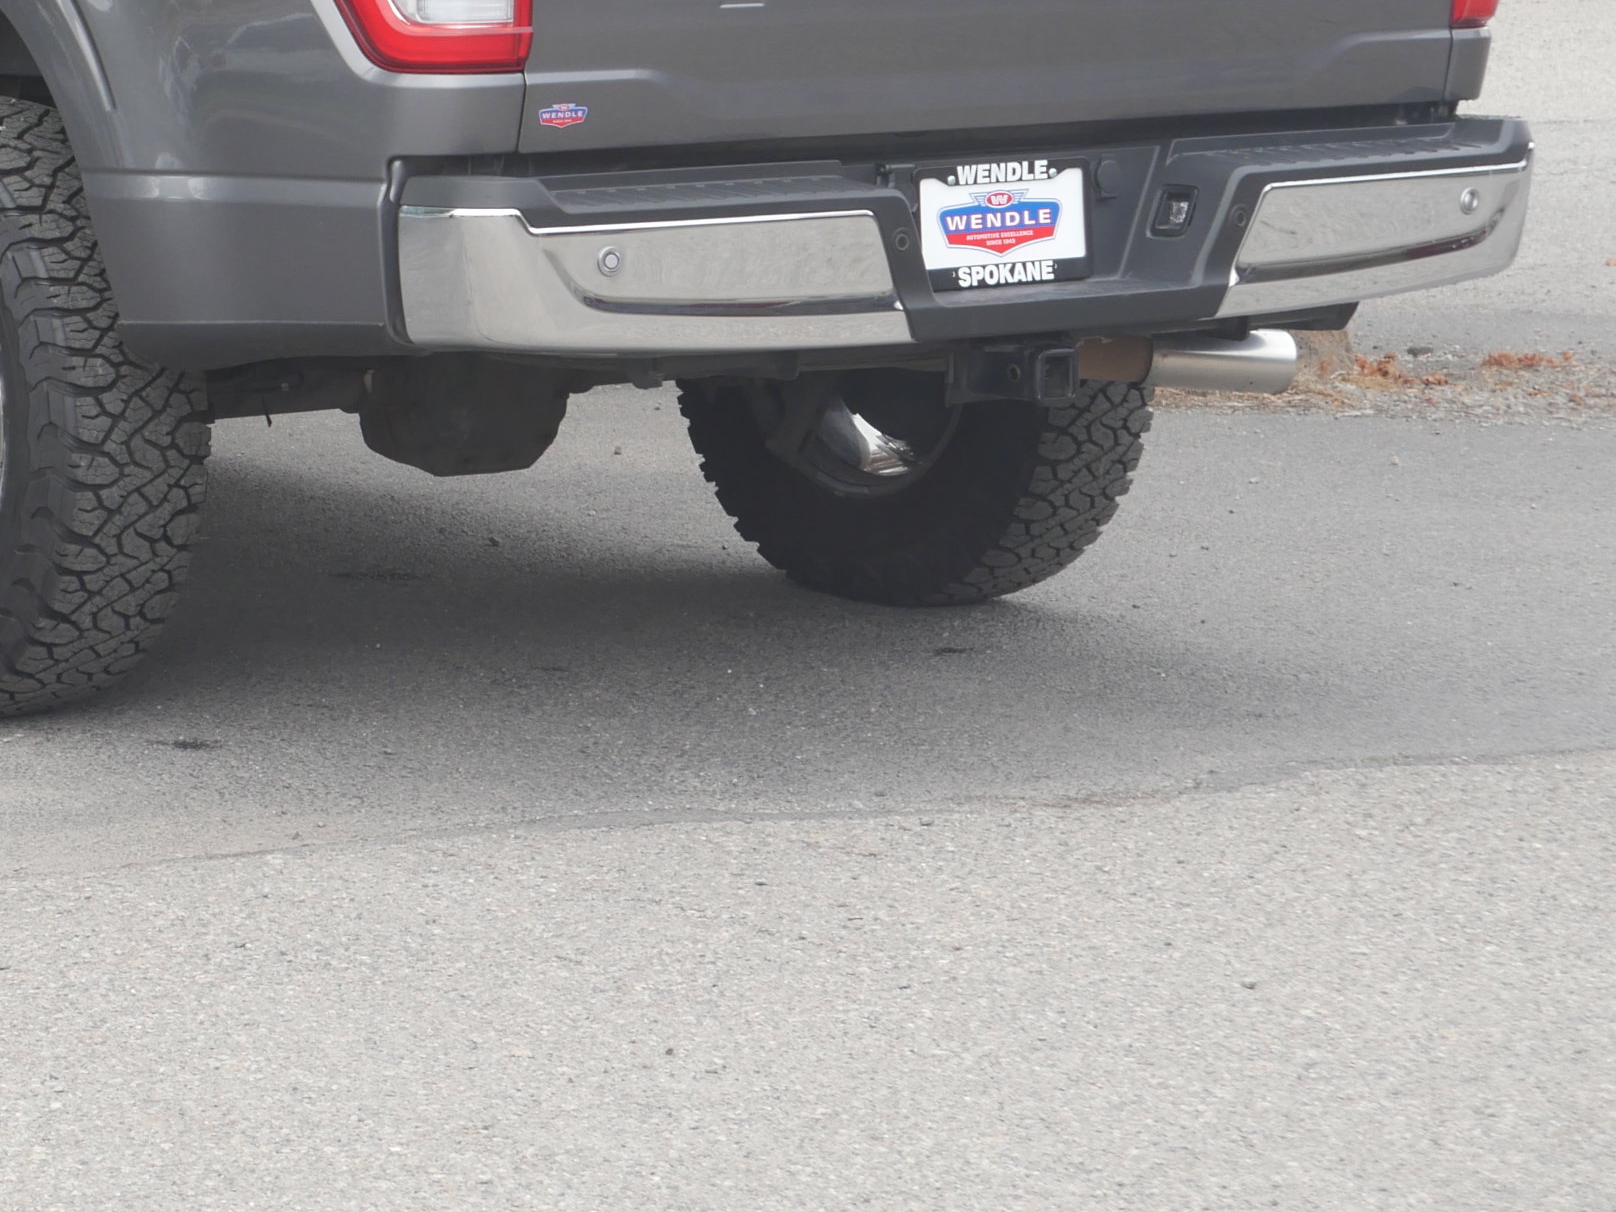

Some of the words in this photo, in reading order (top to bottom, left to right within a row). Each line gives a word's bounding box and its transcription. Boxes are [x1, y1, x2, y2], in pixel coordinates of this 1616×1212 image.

[542, 110, 583, 119] WENDLE
[957, 160, 1048, 185] WENDLE
[990, 194, 1009, 206] W
[946, 208, 1052, 231] WENDLE
[966, 232, 1000, 241] AUTOMOTIVE
[958, 260, 1055, 288] SPOKANE
